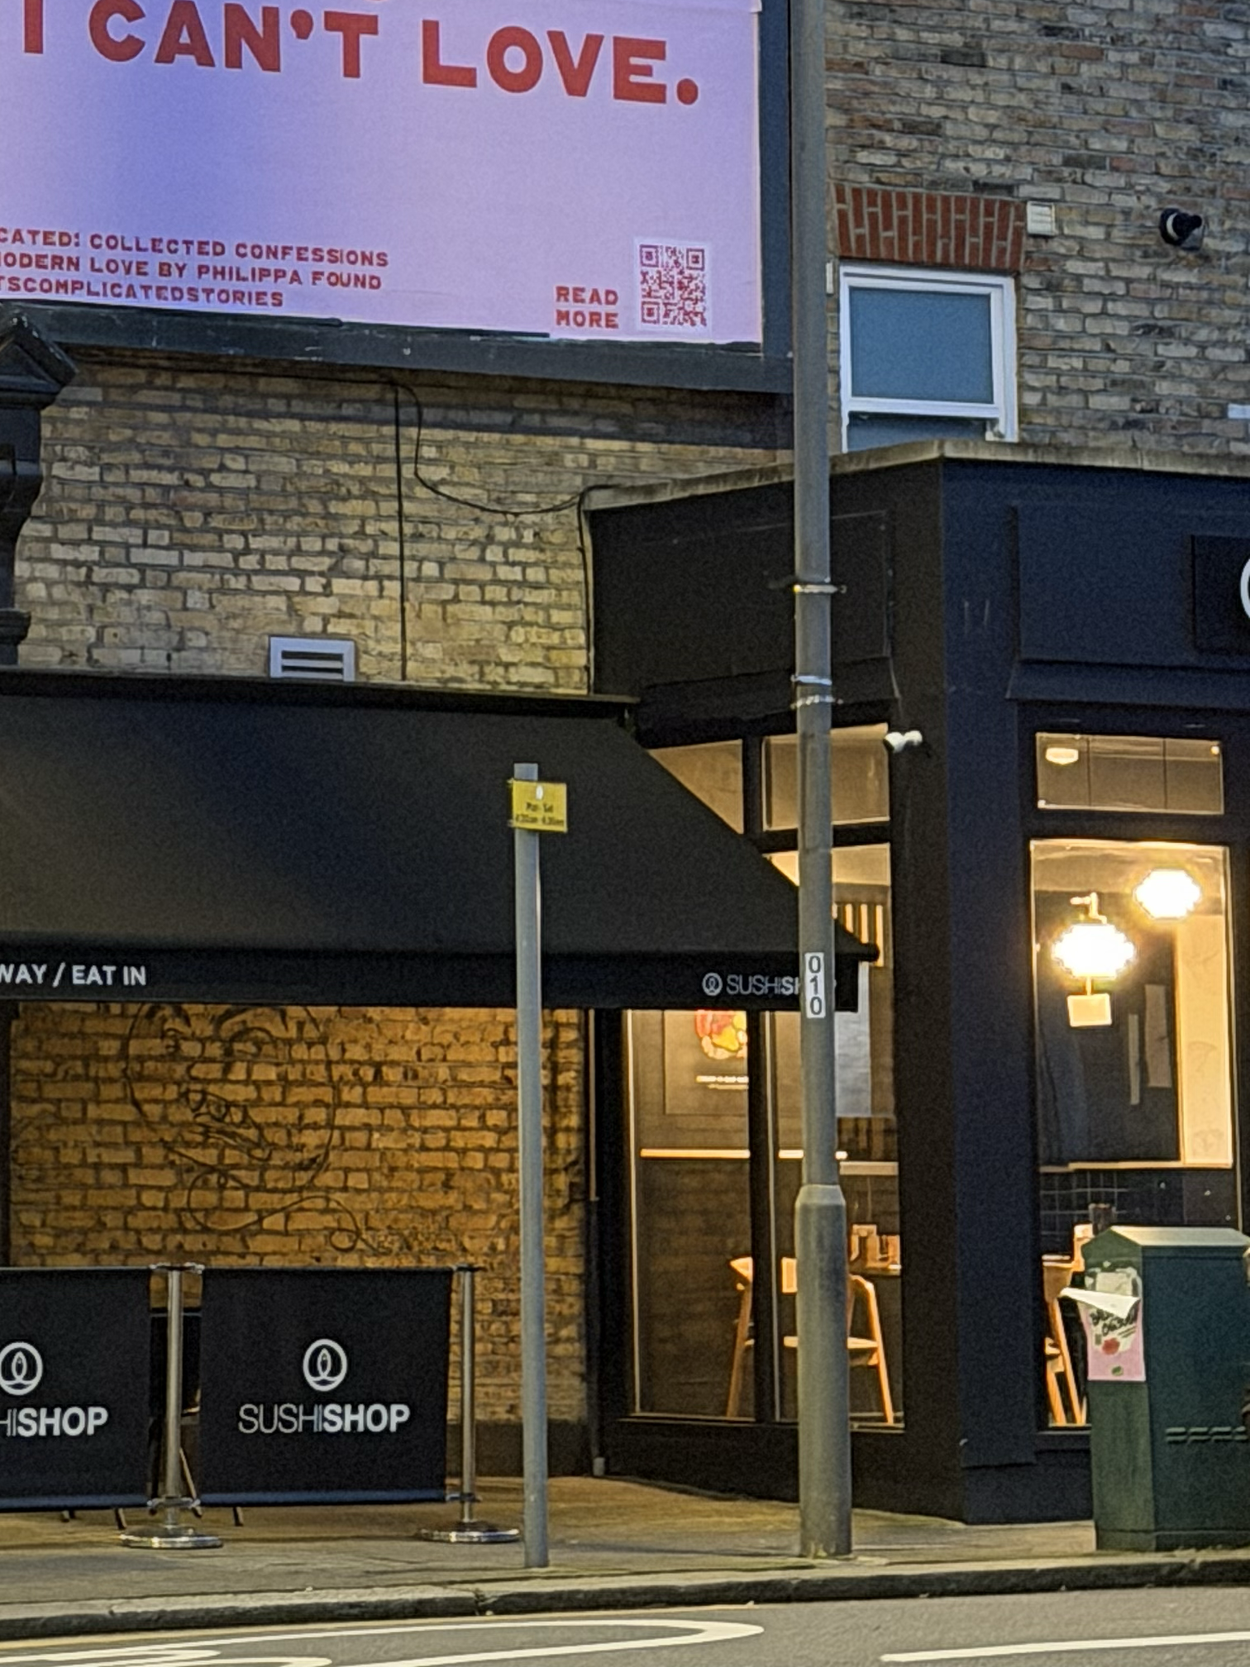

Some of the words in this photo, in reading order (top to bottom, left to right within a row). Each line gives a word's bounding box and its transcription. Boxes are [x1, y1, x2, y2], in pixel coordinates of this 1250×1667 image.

[421, 19, 700, 107] LOVE.
[90, 233, 226, 257] COLLECTED
[235, 242, 389, 267] CONFESSIONS
[90, 256, 149, 277] LOVE
[158, 261, 188, 278] BY
[197, 264, 303, 286] PHILIPPA
[311, 270, 382, 290] FOUND
[555, 285, 619, 306] READ
[555, 309, 619, 329] MORE
[71, 964, 117, 986] EAT
[122, 965, 148, 986] IN
[238, 1403, 411, 1434] SUSHISHOP
